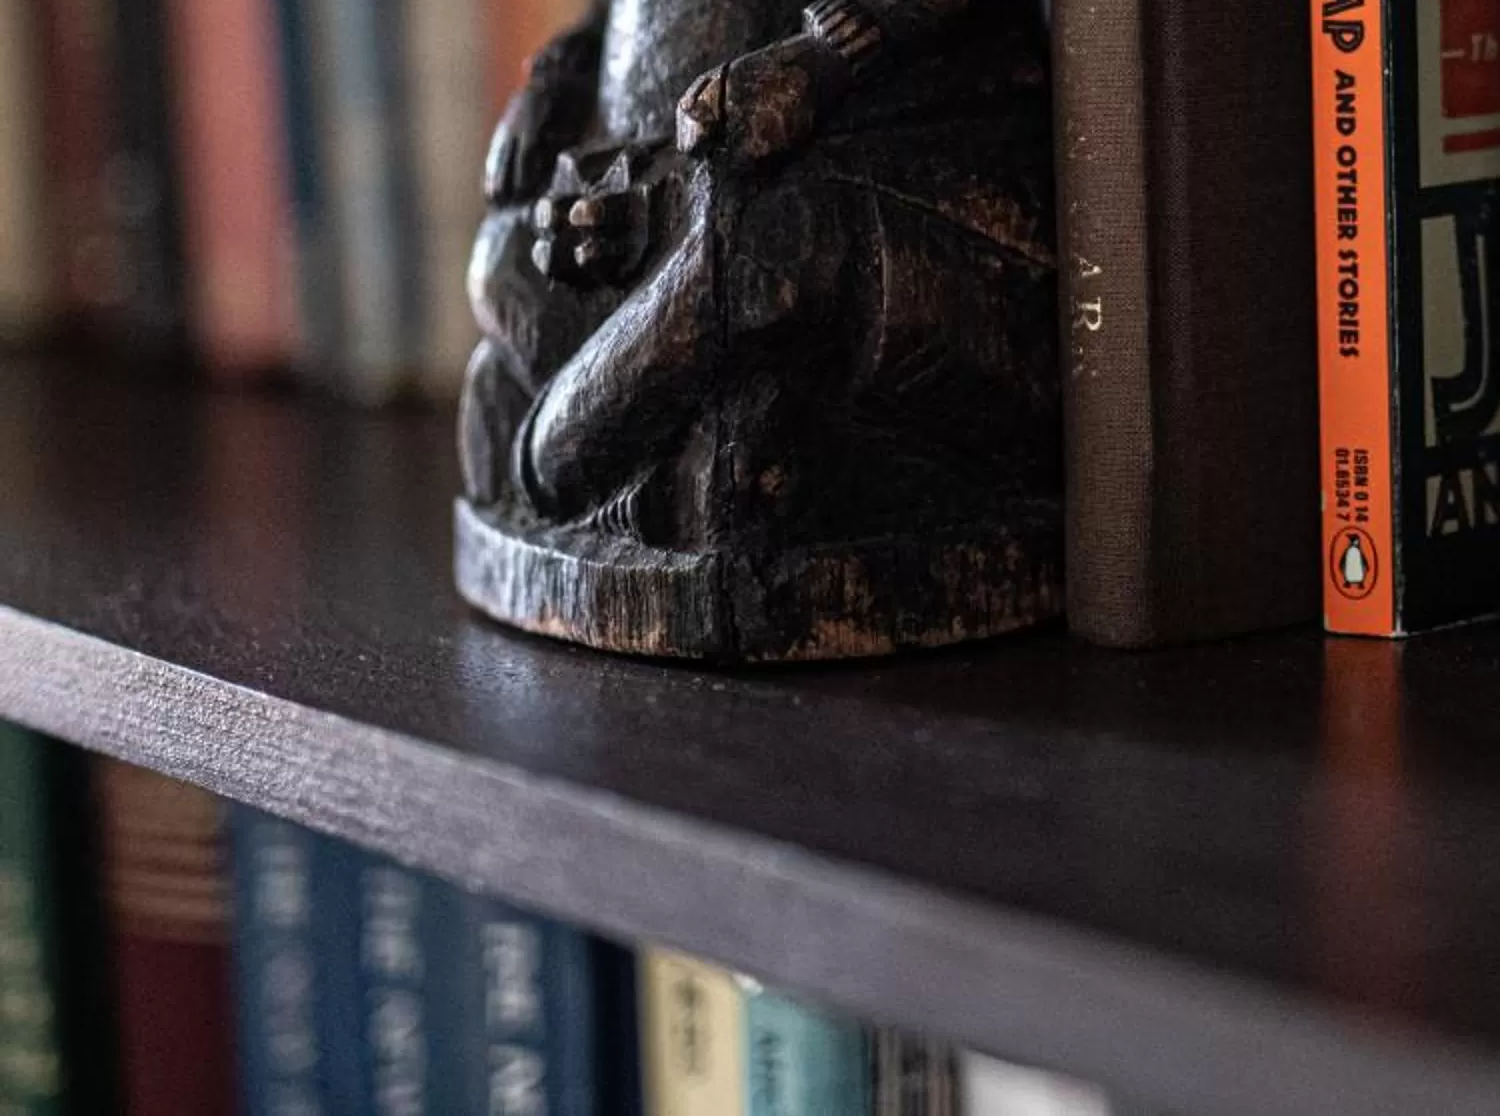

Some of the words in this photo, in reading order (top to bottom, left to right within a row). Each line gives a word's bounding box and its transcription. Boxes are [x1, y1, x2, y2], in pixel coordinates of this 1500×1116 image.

[1334, 68, 1357, 136] AND
[1335, 145, 1358, 241] OTHER
[1337, 249, 1360, 358] STORIES
[1353, 449, 1368, 486] ISBN
[1354, 506, 1368, 521] 14
